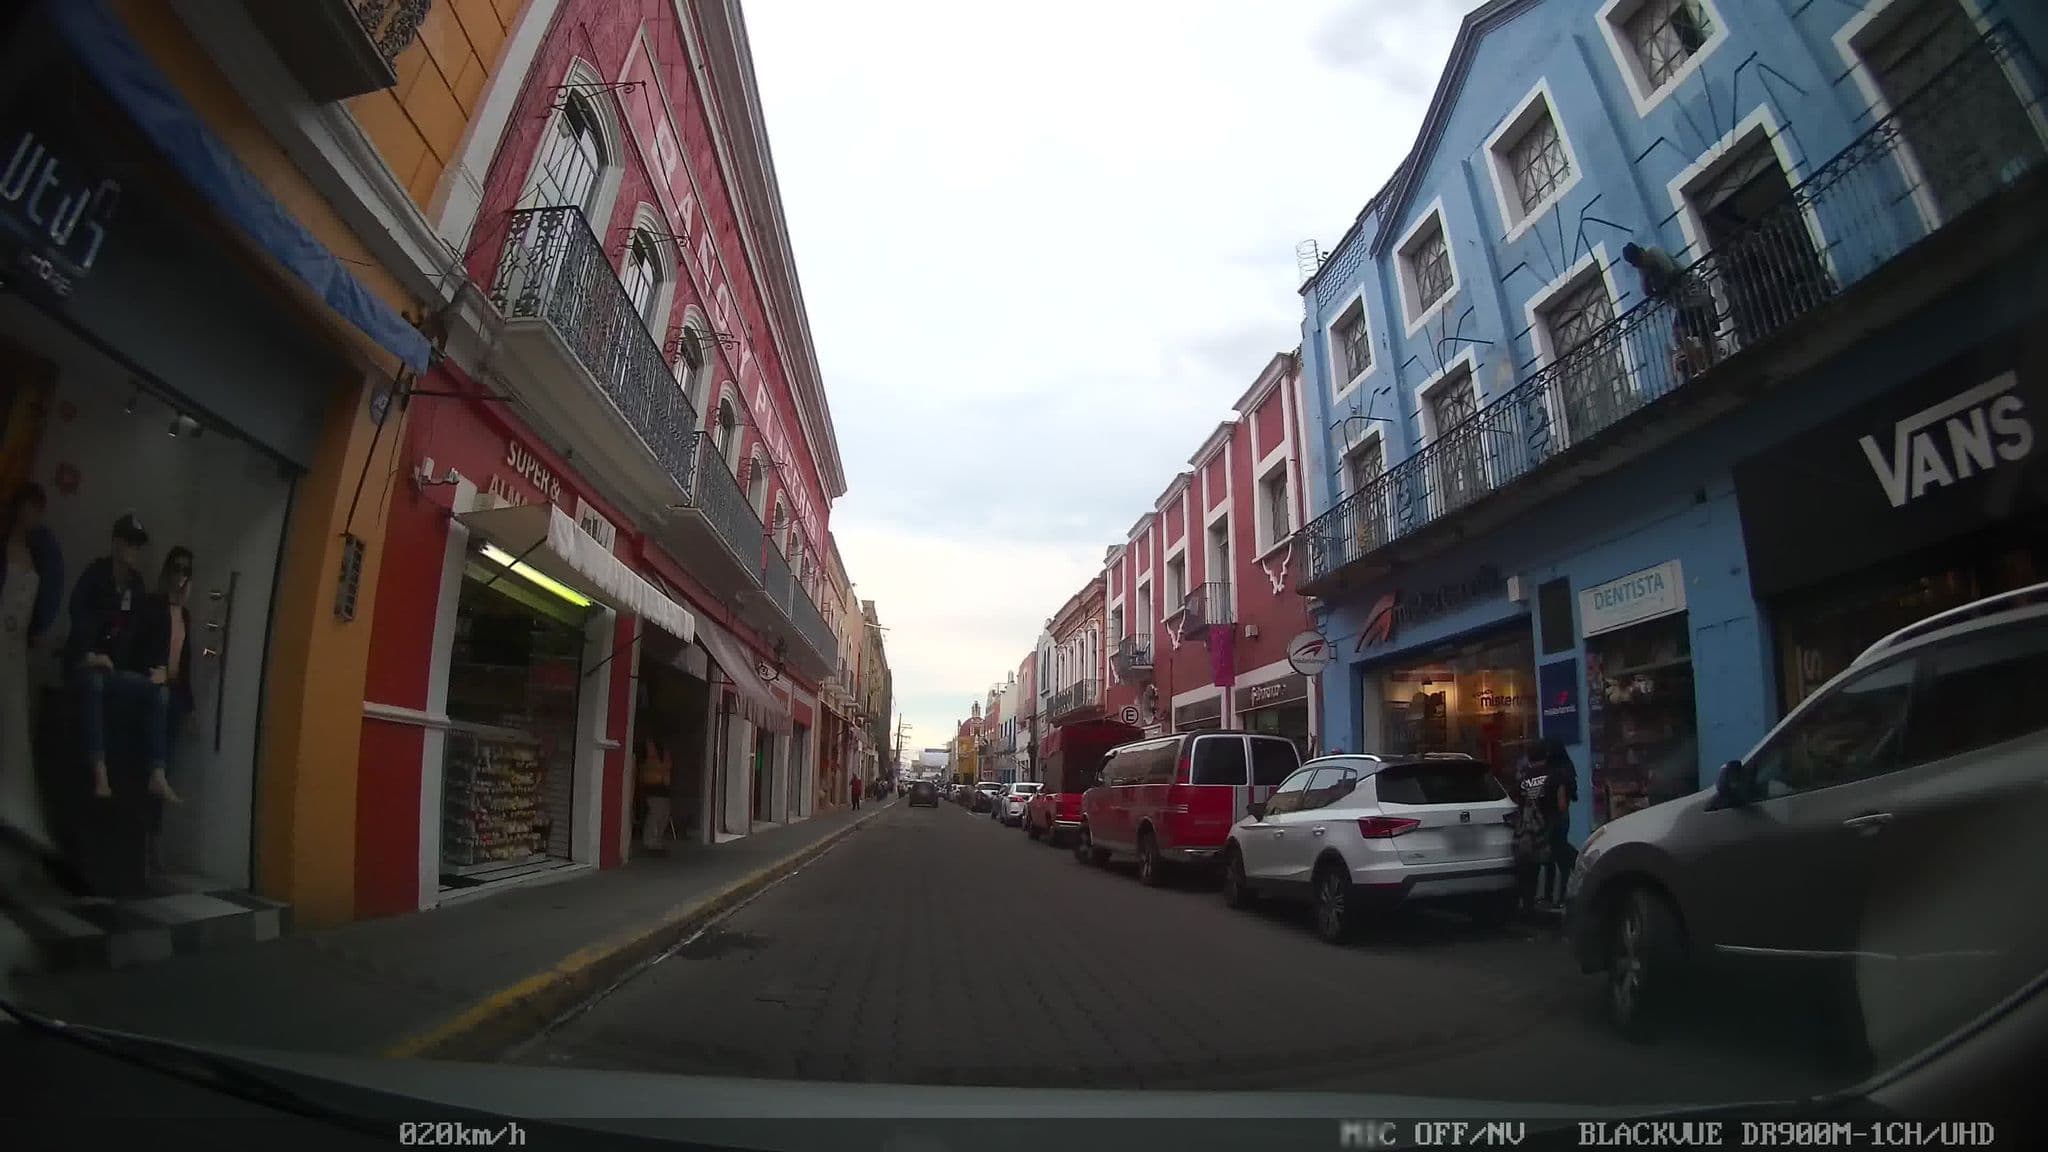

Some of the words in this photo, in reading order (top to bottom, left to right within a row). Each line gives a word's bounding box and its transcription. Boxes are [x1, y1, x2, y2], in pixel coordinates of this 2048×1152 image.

[1858, 370, 2033, 508] VANS
[506, 440, 550, 494] SUPER
[550, 476, 562, 502] &
[1593, 572, 1665, 611] DENTISTA
[1125, 709, 1135, 722] E
